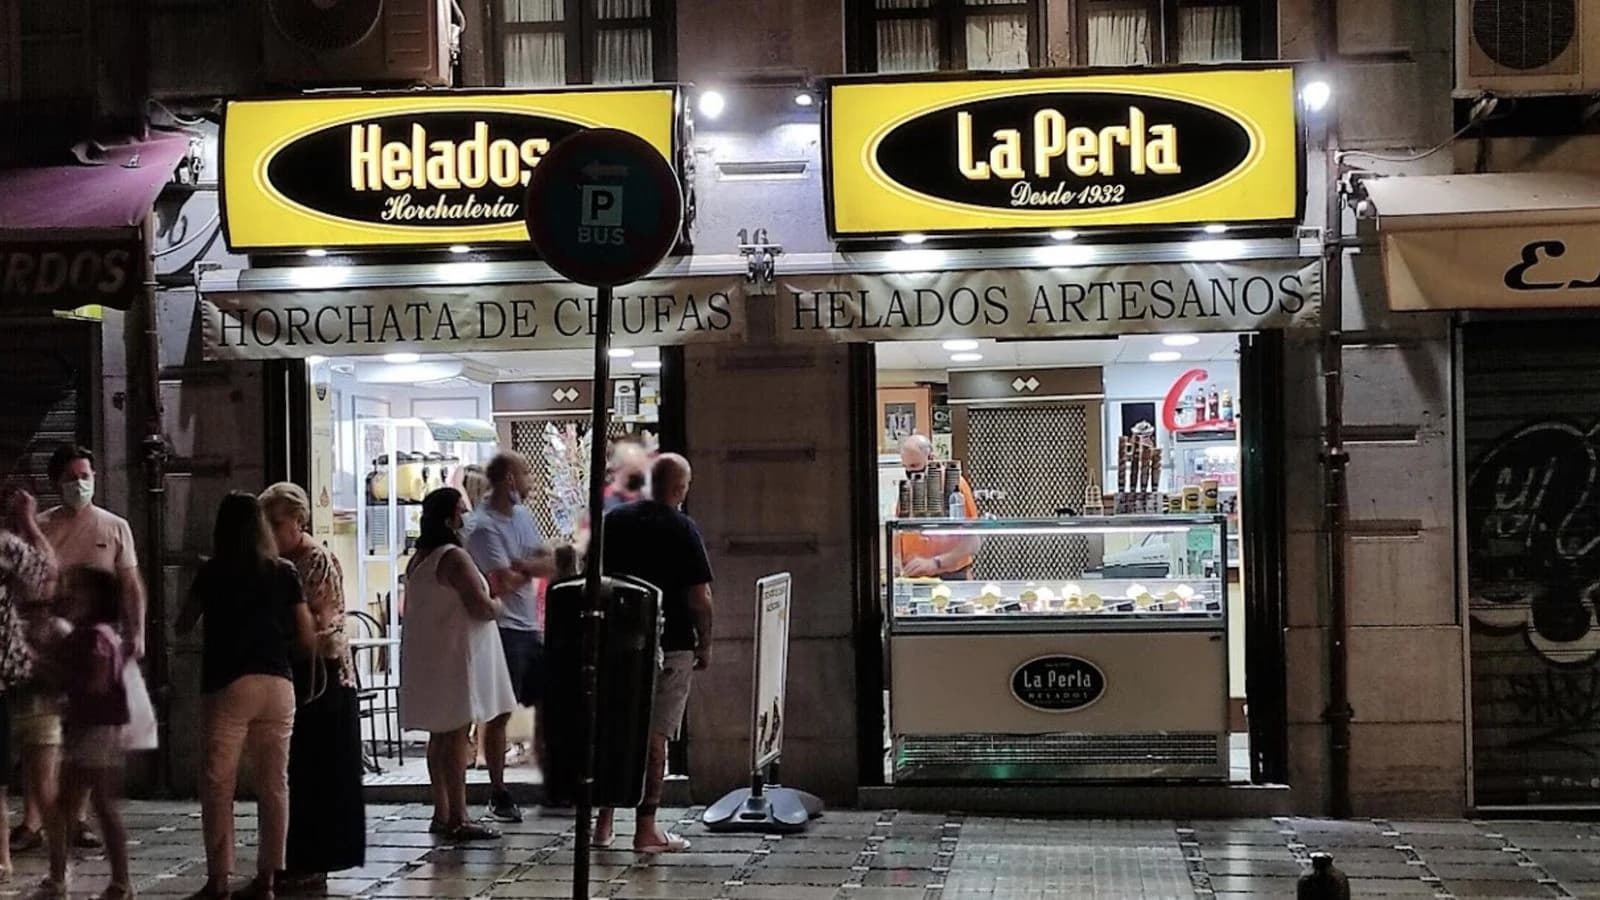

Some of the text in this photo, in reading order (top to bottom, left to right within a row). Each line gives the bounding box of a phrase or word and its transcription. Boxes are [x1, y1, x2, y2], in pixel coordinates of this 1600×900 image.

[351, 121, 550, 191] Helados
[957, 106, 1181, 179] La Perla
[381, 193, 519, 220] Horchatería
[591, 190, 614, 220] P
[1010, 181, 1125, 206] Desde 1932
[577, 226, 625, 245] BUS
[791, 275, 1304, 330] HELADOS ARTESANOS
[218, 302, 461, 347] HORCHATA
[476, 300, 538, 339] DE
[1023, 669, 1092, 688] La Perla
